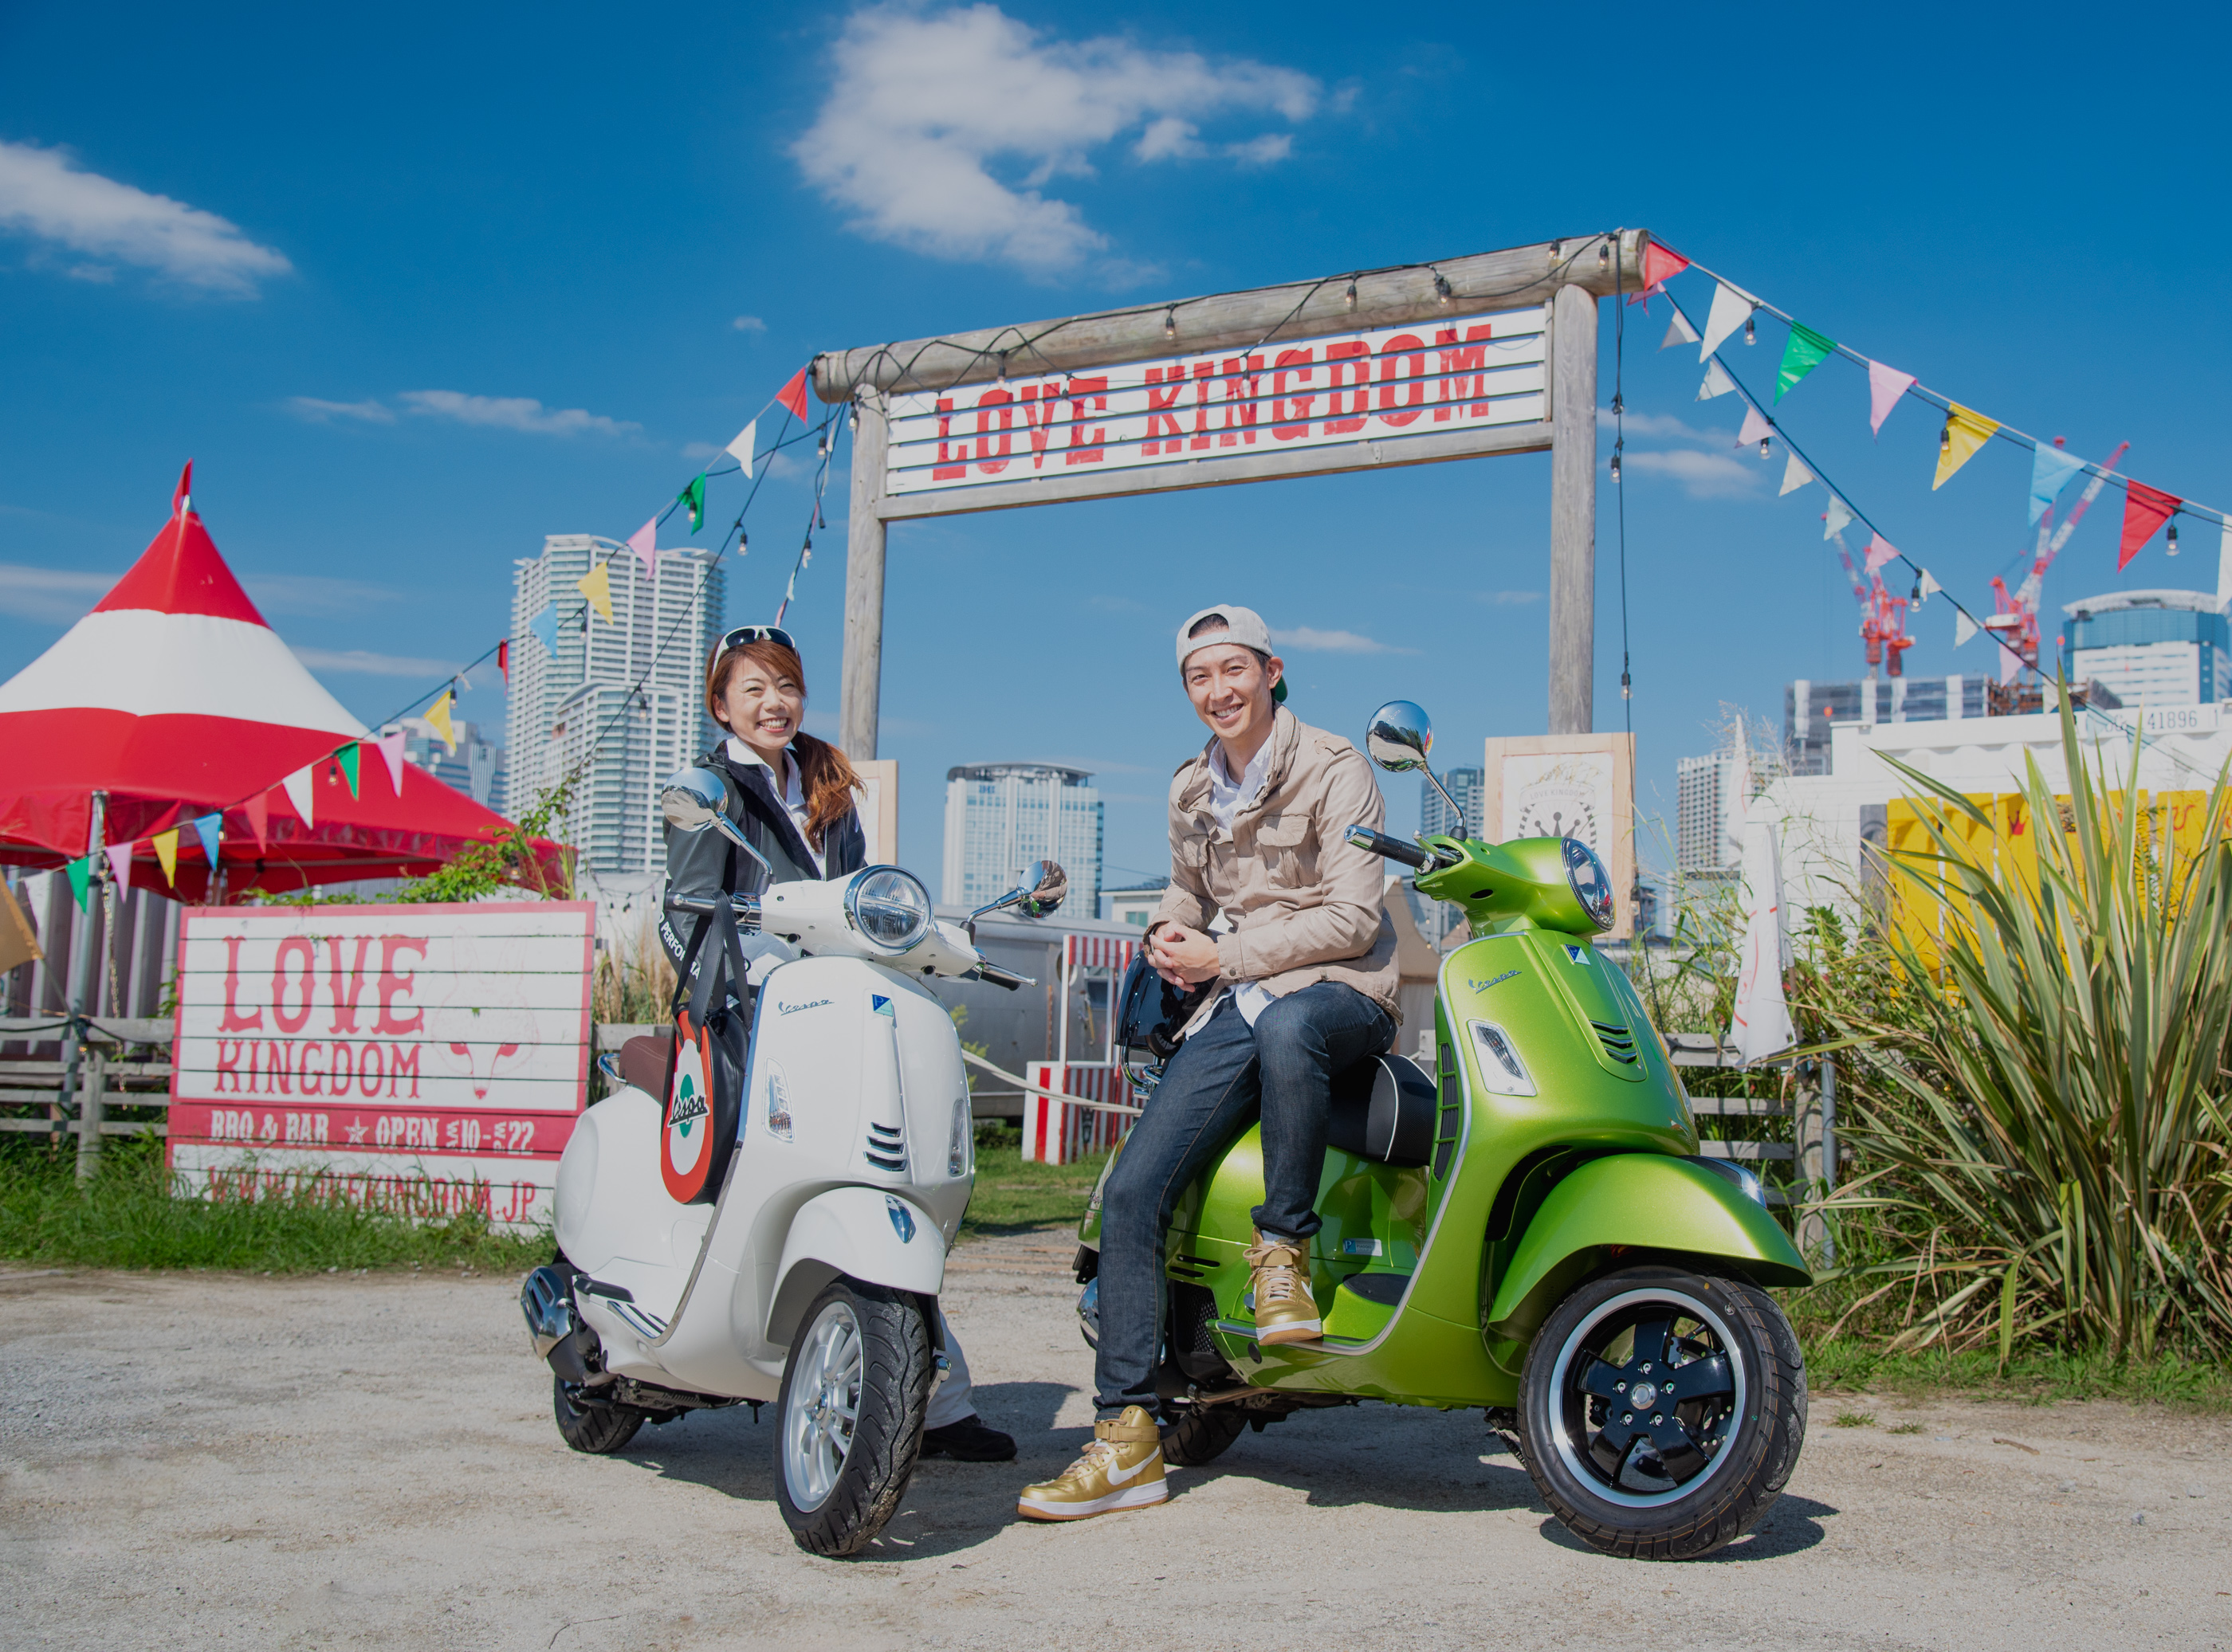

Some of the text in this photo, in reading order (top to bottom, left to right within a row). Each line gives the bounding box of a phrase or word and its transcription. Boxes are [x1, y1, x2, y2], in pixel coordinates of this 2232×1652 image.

[932, 324, 1493, 482] LOVE KINGDOM
[1531, 790, 1548, 800] LOVE
[218, 934, 429, 1035] LOVE
[1468, 970, 1522, 995] Vespa
[778, 1001, 835, 1016] Vespa
[214, 1039, 423, 1099] KINGDOM
[669, 1094, 709, 1125] Vespa
[209, 1109, 254, 1144] BBQ
[260, 1113, 278, 1144] &
[285, 1112, 329, 1146] BAR
[375, 1116, 440, 1152] OPEN
